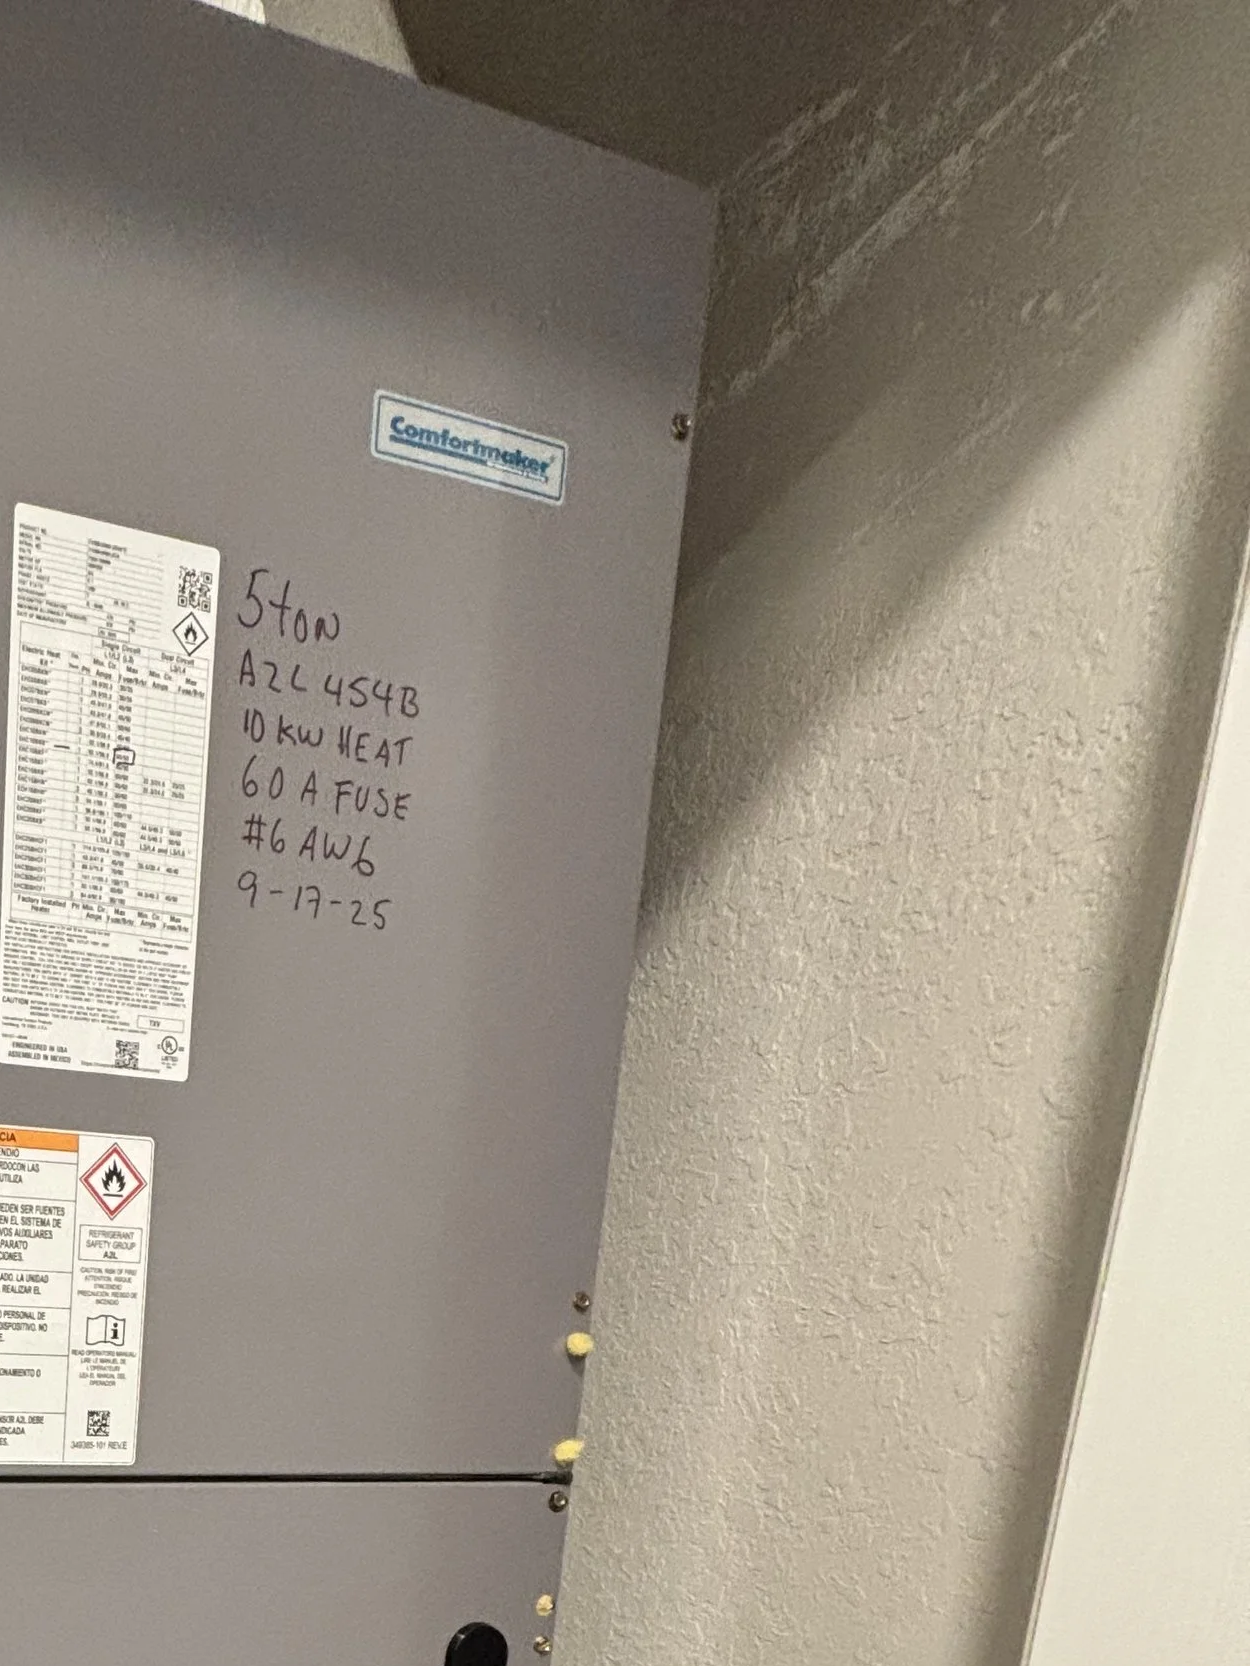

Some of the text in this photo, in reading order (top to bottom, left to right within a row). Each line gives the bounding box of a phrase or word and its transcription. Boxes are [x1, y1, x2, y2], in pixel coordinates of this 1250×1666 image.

[389, 415, 551, 473] Comfortmaker
[239, 648, 420, 718] A2L 454B
[244, 708, 265, 743] 10
[337, 725, 413, 768] HEAT
[300, 769, 318, 806] A
[334, 780, 412, 820] FUSE
[242, 813, 286, 854] #6
[237, 870, 392, 930] 9-17-25
[2, 996, 28, 1005] CAUTION
[0, 1173, 22, 1183] UTILIZA
[85, 1239, 137, 1251] SAFETY GROUP
[88, 1229, 135, 1240] REFRIGERANT
